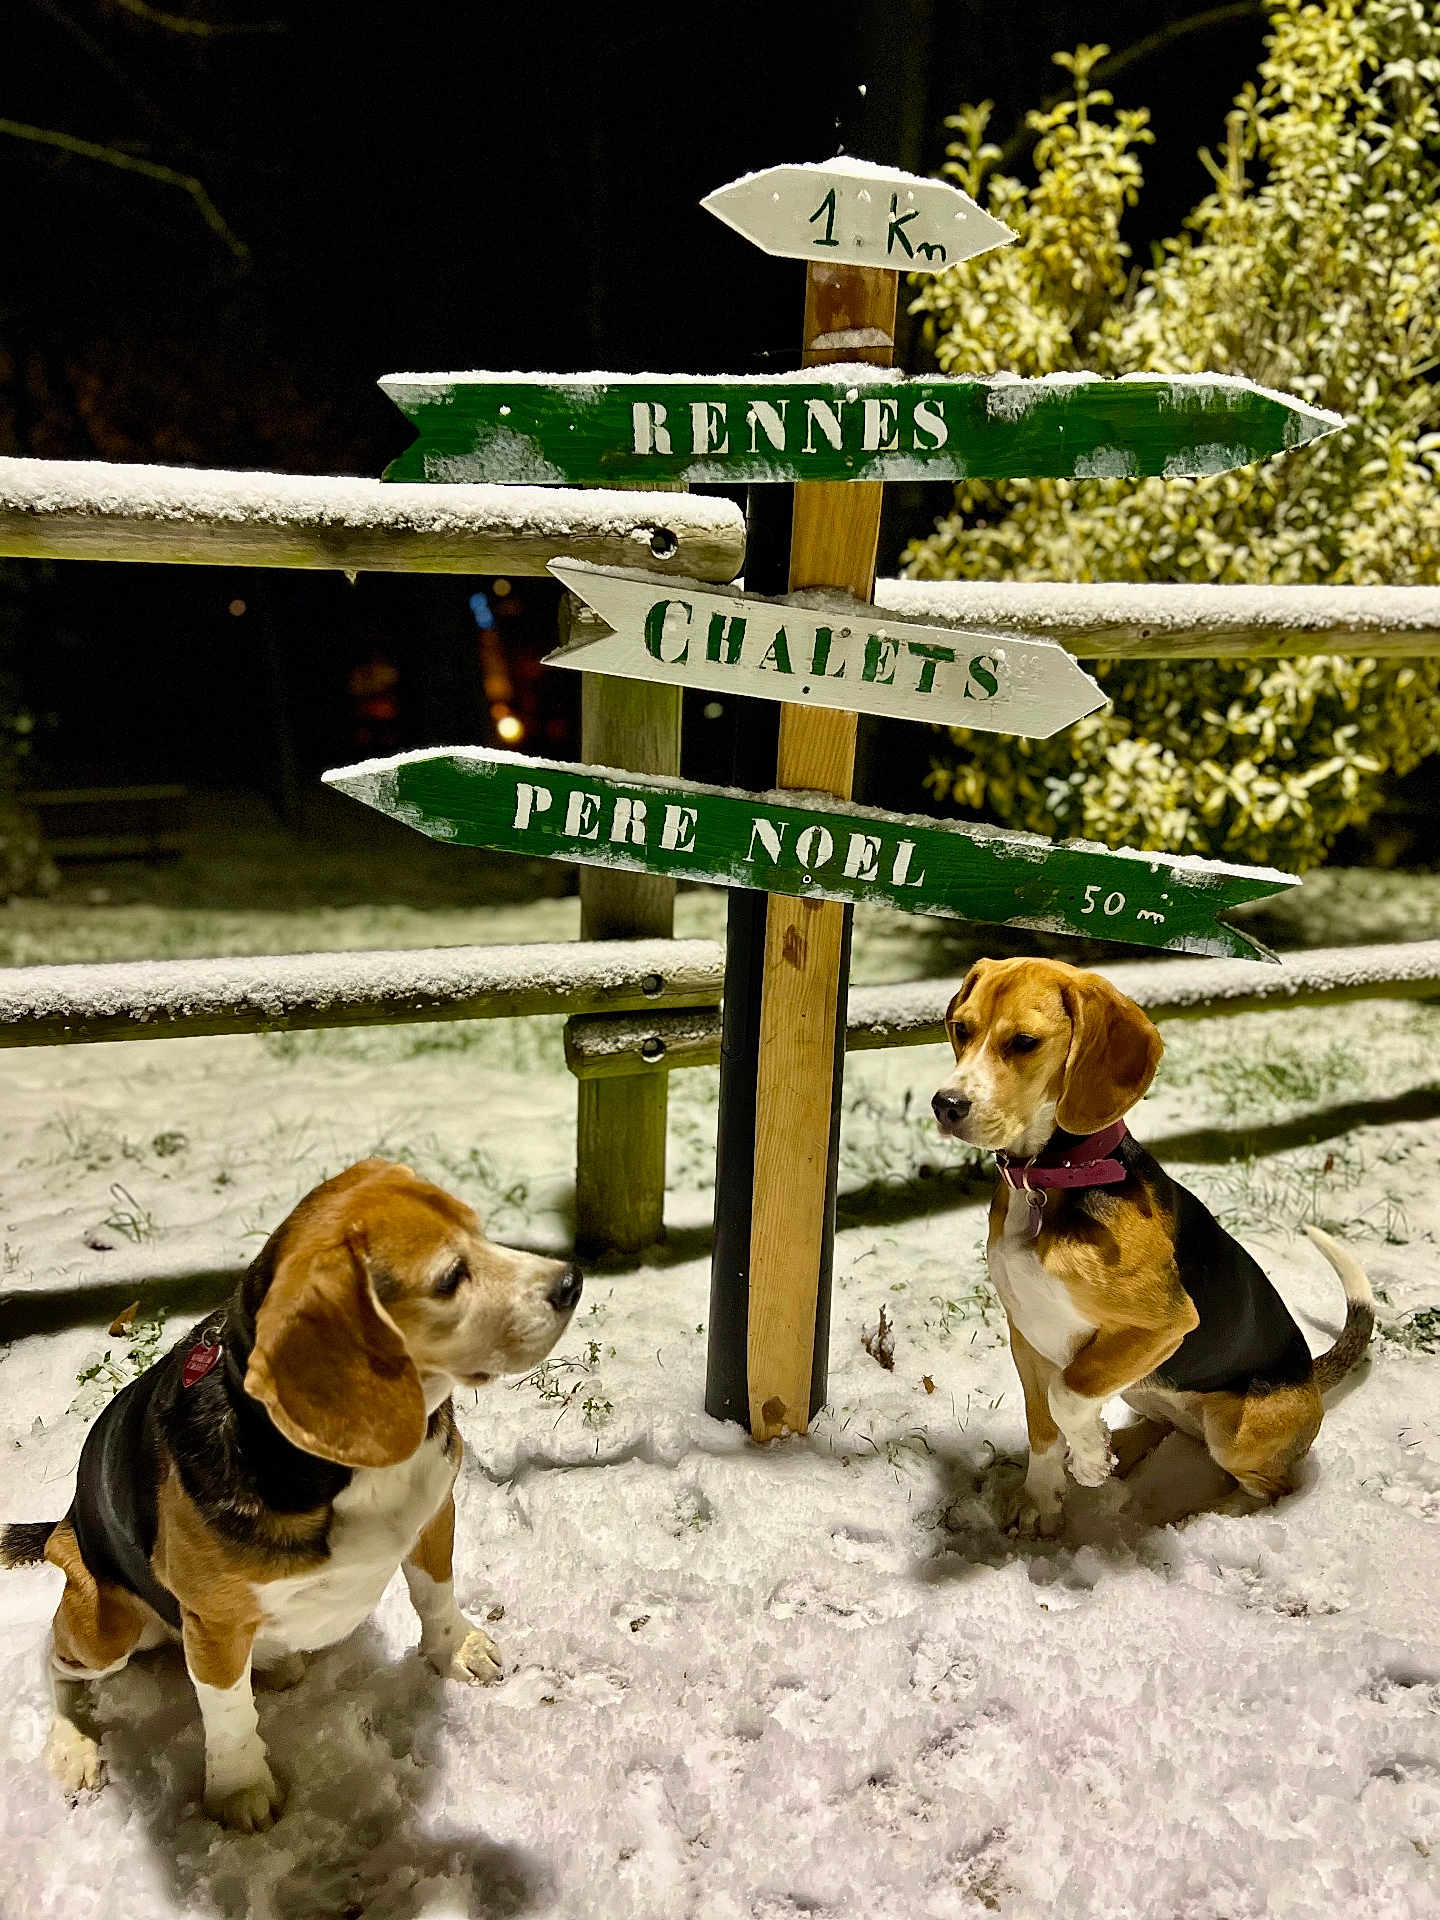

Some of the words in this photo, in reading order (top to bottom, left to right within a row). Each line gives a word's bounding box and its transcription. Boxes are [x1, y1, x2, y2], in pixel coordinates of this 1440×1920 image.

[808, 188, 839, 247] 1
[631, 399, 949, 455] RENNES
[644, 599, 999, 701] CHALETS
[512, 782, 698, 853] PERE
[741, 817, 926, 888] NOEL
[1080, 885, 1126, 916] 50
[1136, 909, 1165, 925] m
